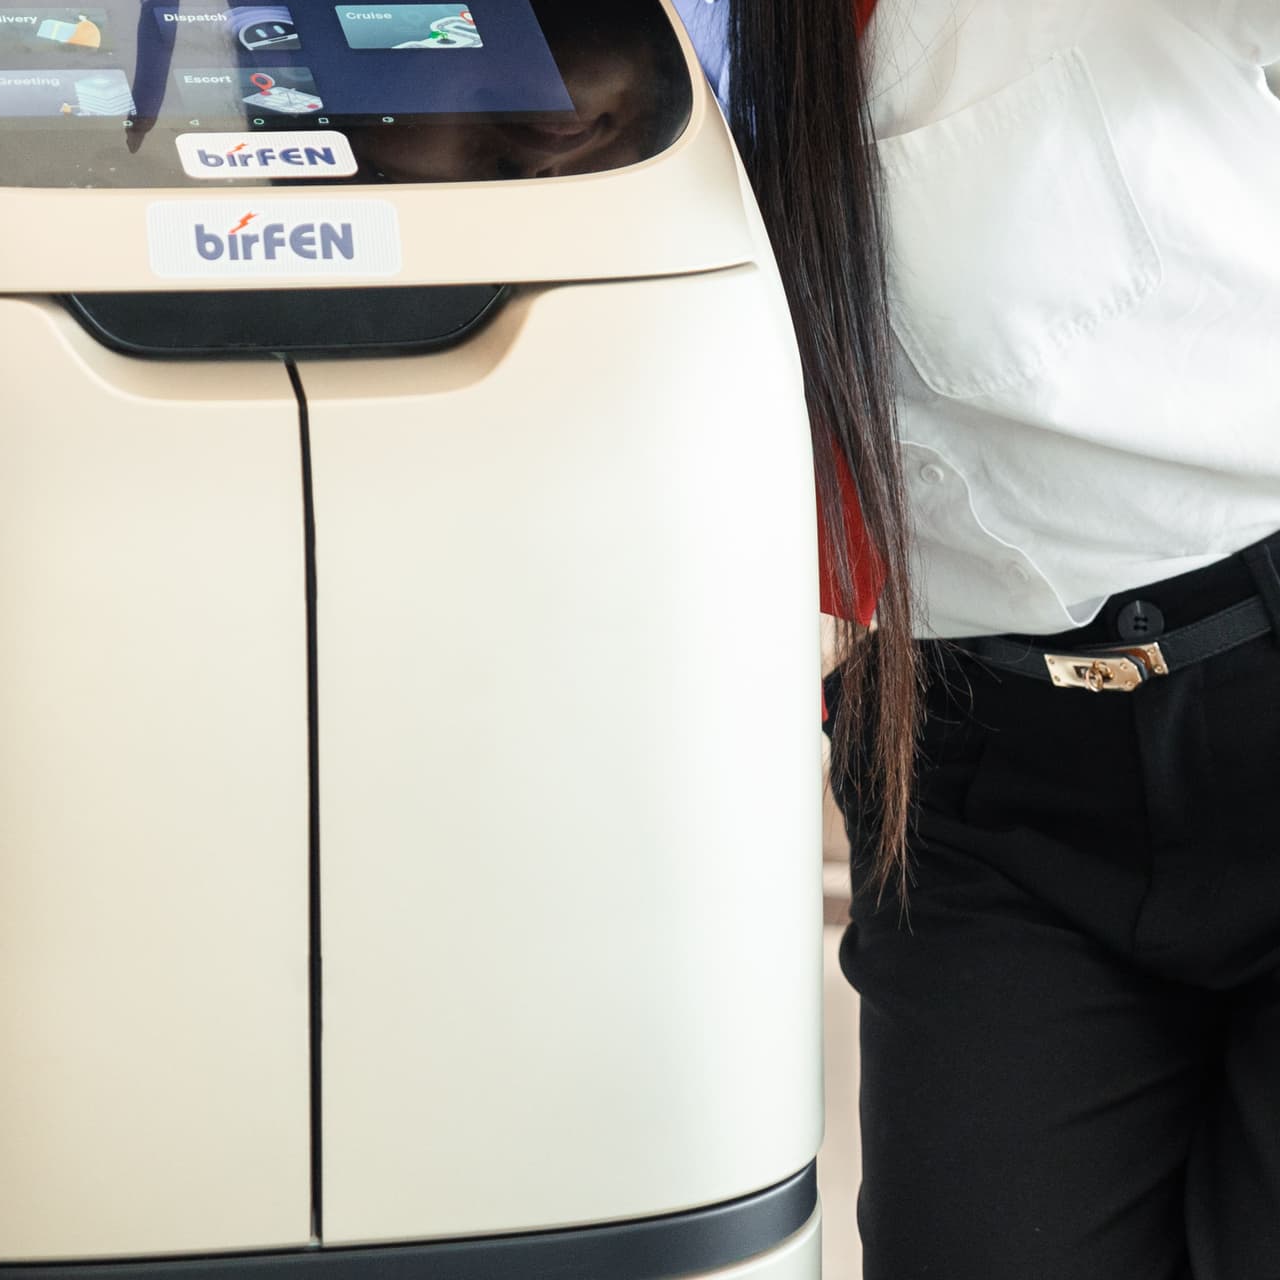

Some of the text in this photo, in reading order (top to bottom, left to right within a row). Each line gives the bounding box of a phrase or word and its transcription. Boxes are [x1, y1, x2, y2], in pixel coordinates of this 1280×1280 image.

[164, 13, 228, 23] Dispatch
[346, 10, 392, 20] Cruise
[184, 74, 232, 84] Escort
